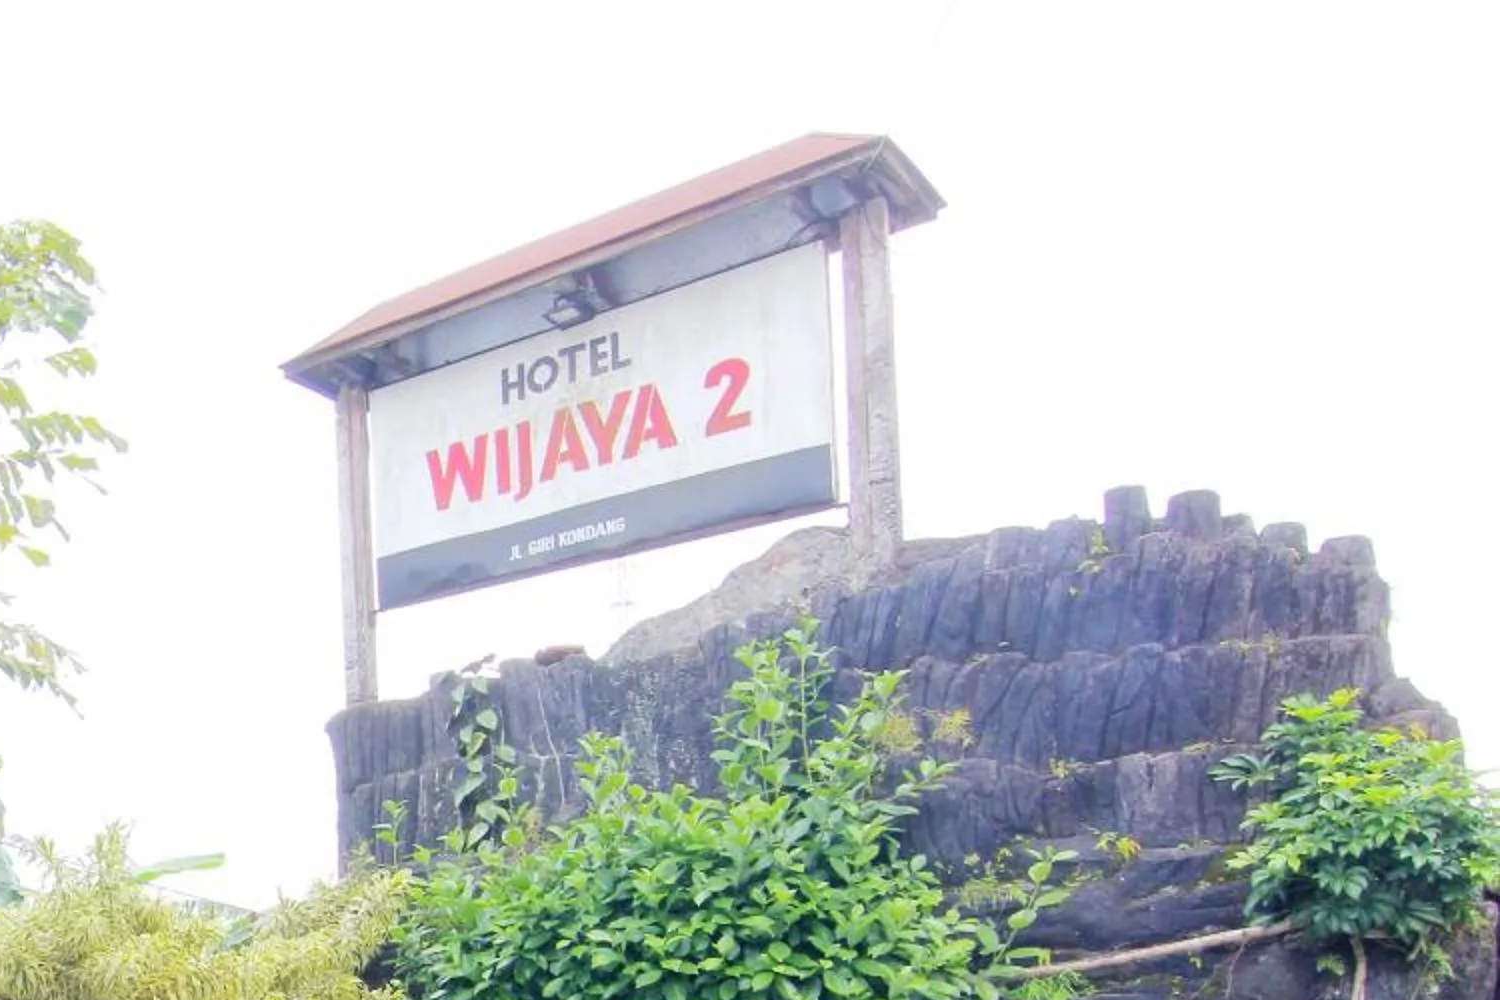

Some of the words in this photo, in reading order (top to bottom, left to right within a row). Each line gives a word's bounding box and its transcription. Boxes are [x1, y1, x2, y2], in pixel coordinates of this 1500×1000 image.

[501, 332, 632, 404] HOTEL
[426, 384, 678, 510] WIJAYA
[704, 357, 752, 437] 2
[528, 534, 554, 556] GIRI
[558, 516, 626, 548] KONDANG
